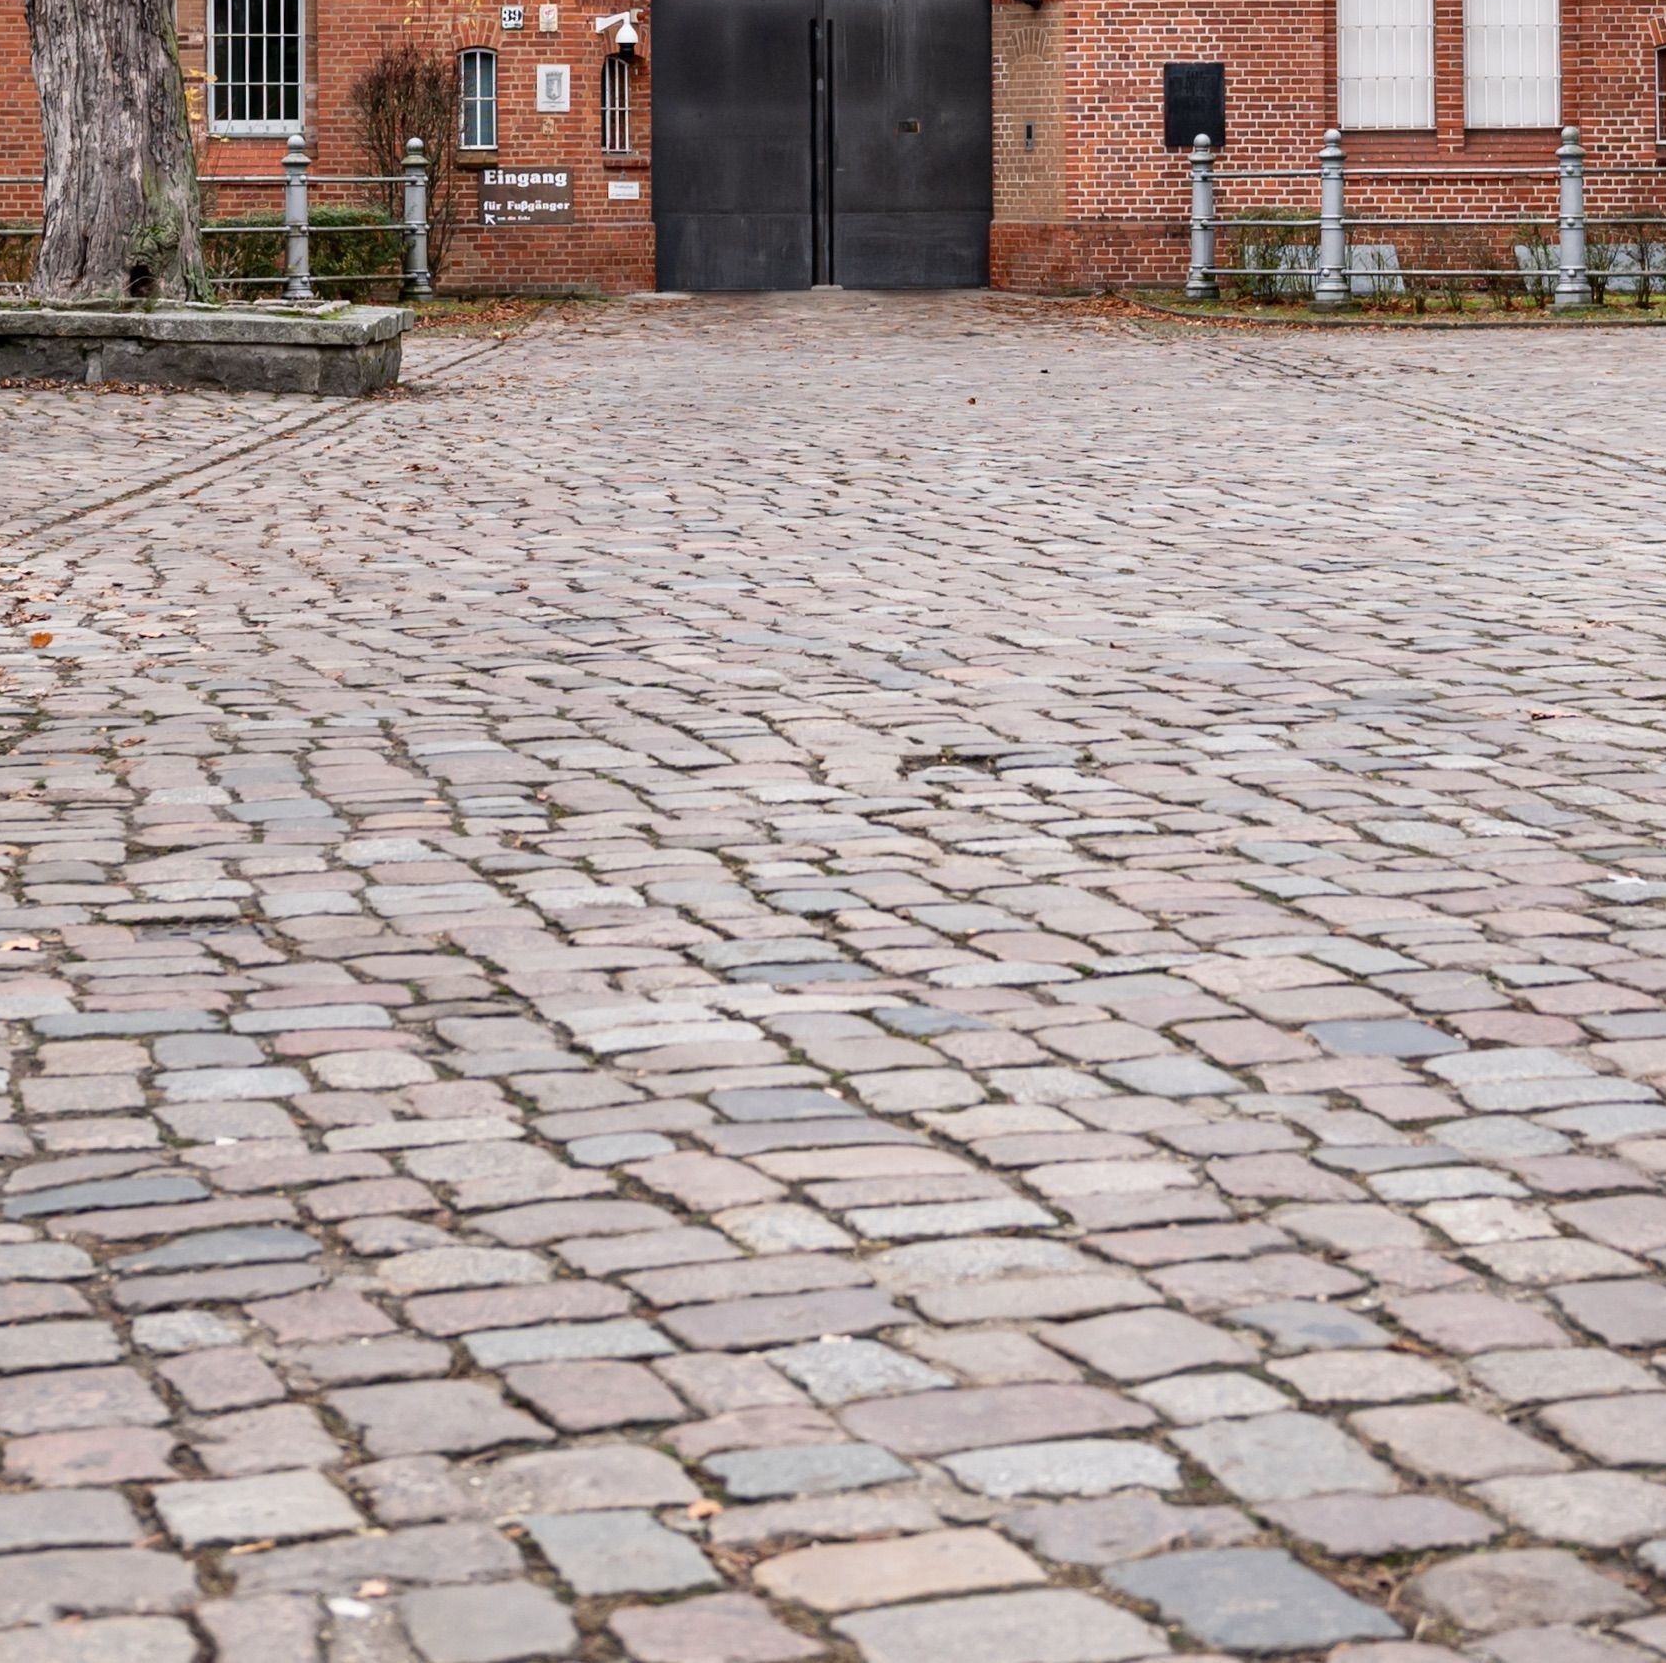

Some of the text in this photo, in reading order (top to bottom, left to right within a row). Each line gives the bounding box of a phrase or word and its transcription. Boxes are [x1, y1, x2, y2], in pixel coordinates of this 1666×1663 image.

[503, 9, 522, 22] 39
[483, 169, 568, 187] Eingang
[483, 199, 570, 212] für Fußgänger
